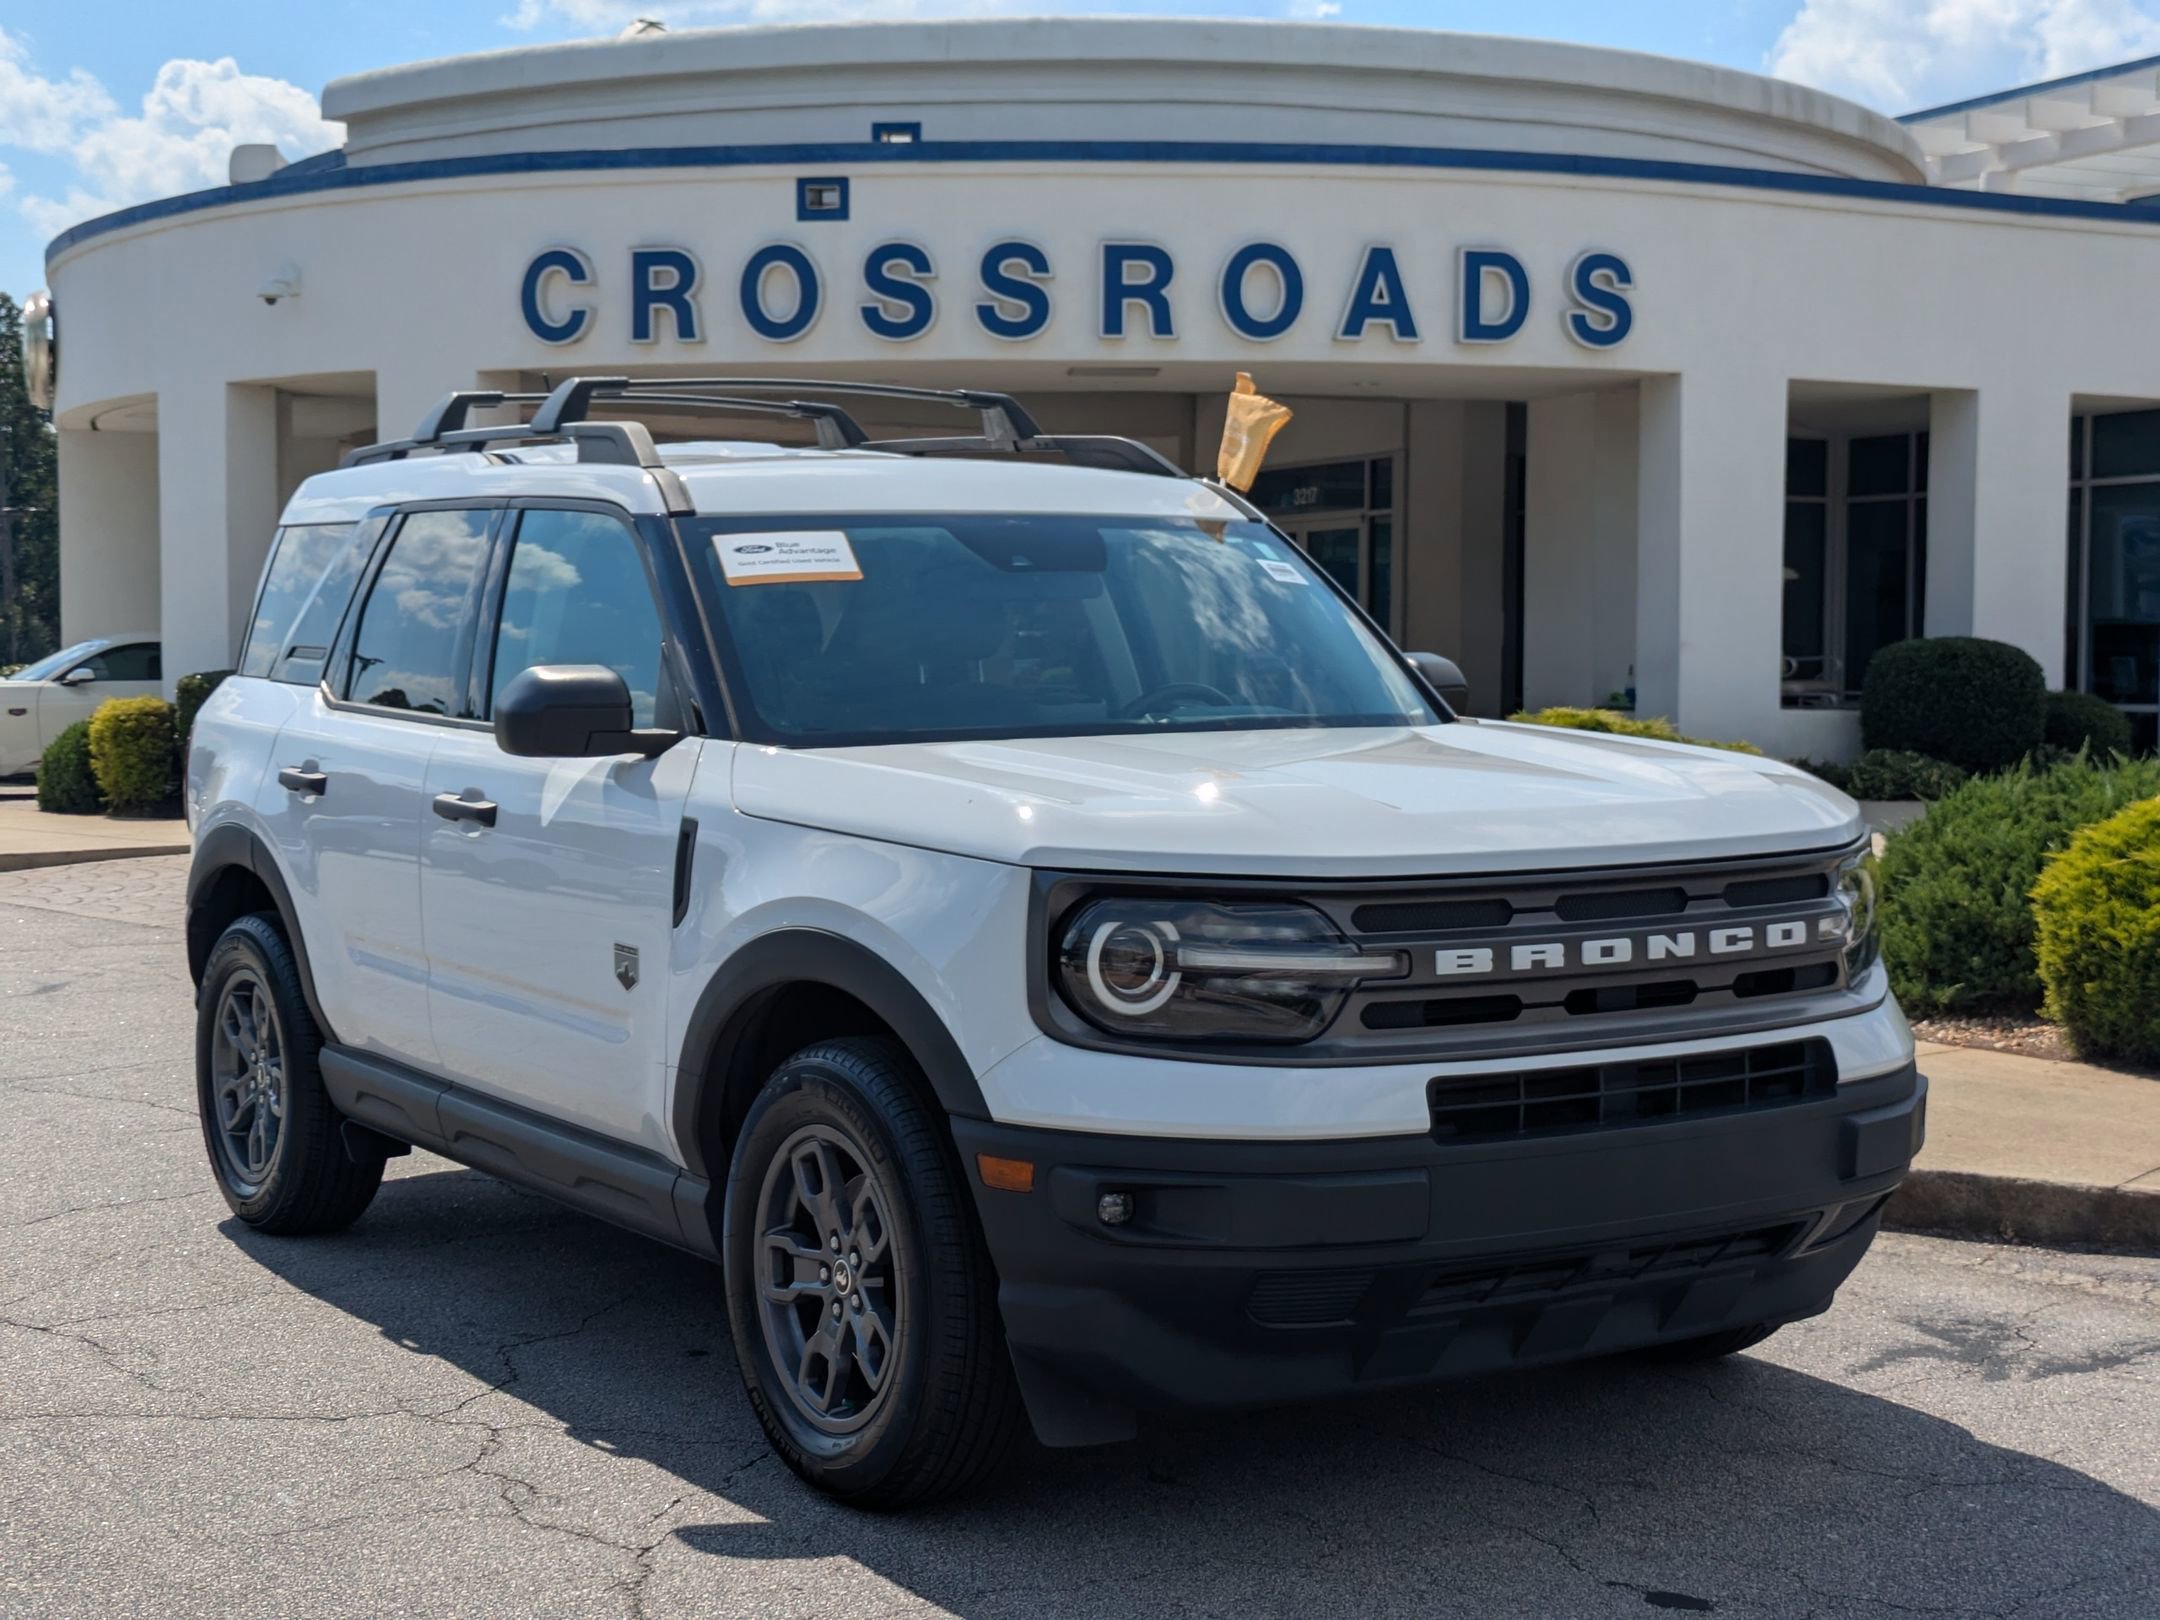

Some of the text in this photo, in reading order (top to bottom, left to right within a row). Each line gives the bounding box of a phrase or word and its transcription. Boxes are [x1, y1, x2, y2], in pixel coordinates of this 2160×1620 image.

[520, 241, 1636, 347] CROSSROADS
[735, 545, 770, 554] Ford
[1435, 921, 1806, 976] BRONCO
